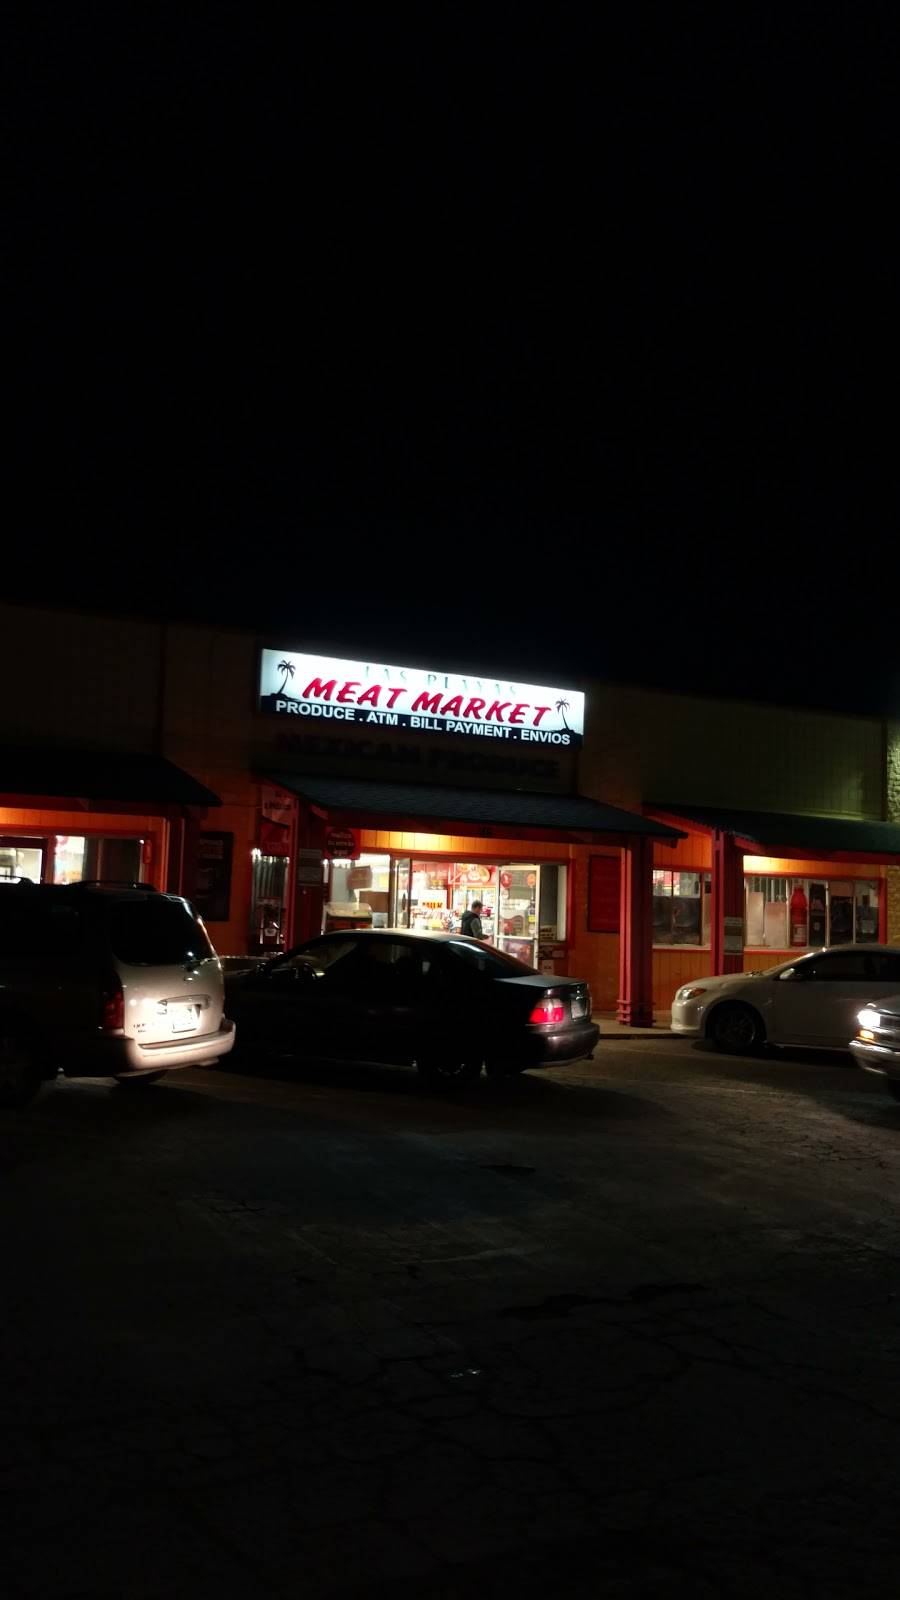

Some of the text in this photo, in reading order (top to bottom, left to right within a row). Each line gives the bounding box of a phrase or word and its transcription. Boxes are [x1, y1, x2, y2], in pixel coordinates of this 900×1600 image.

[276, 700, 570, 745] PRODUCE ATM BILL PAYMENT ENVIOS
[302, 677, 551, 726] MEAT MARKET
